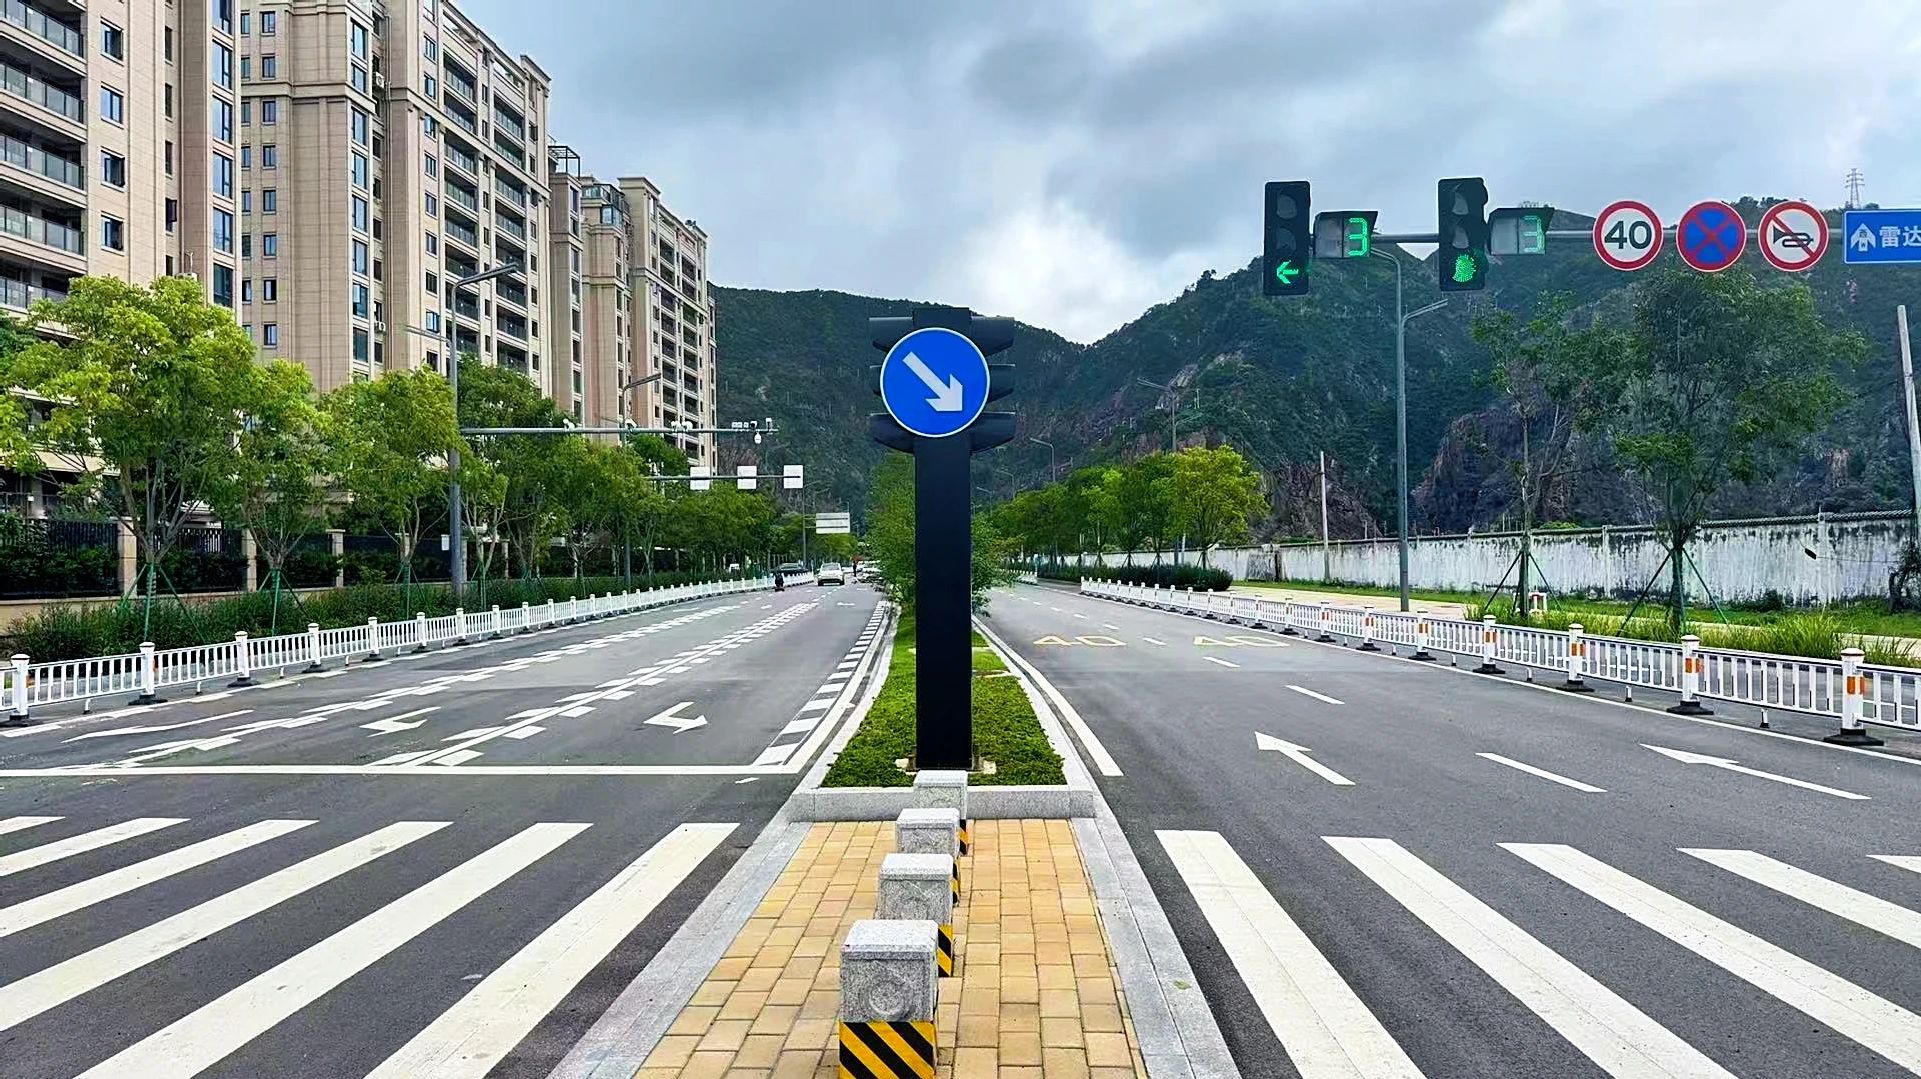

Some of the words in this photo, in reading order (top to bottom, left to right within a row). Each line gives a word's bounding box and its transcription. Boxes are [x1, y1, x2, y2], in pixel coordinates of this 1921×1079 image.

[1347, 217, 1368, 256] 3
[1521, 215, 1546, 253] 3
[1604, 220, 1652, 249] 40
[1879, 225, 1921, 248] 雷达
[1033, 635, 1128, 646] 40
[1194, 635, 1290, 647] 40
